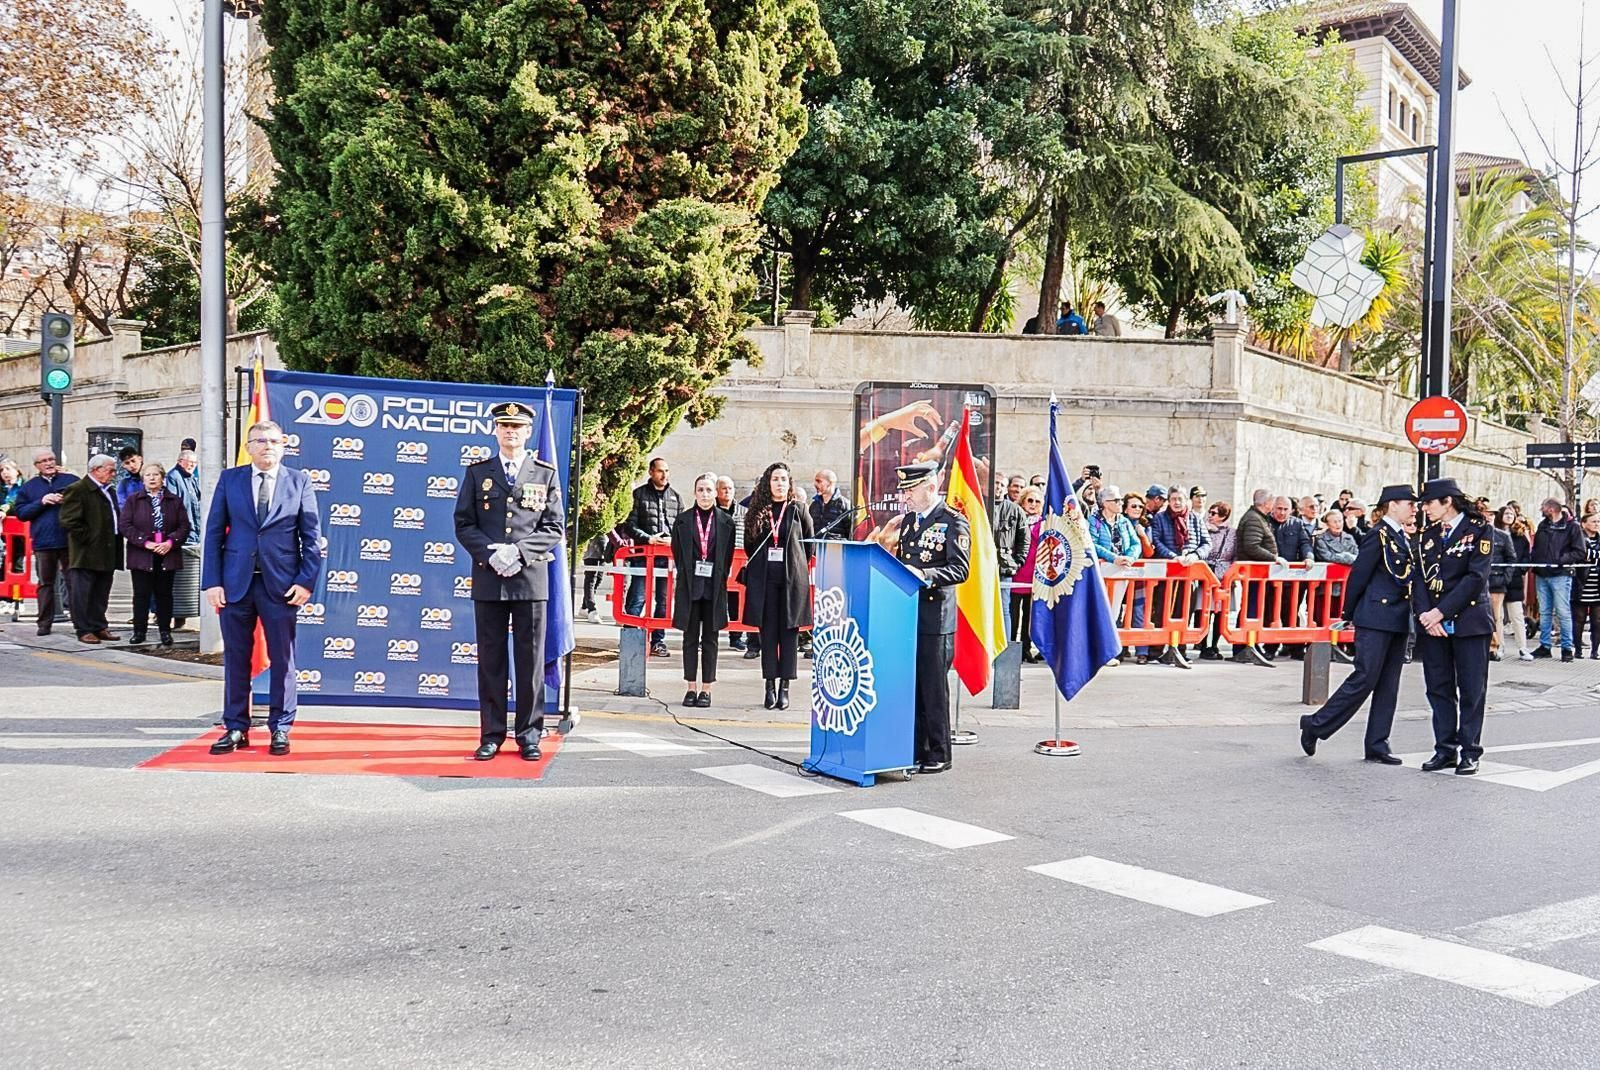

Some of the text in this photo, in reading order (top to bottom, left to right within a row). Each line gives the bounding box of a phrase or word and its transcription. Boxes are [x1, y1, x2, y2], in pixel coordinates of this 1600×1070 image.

[294, 390, 378, 427] 200
[382, 414, 496, 435] NACION
[333, 437, 363, 451] 200
[397, 442, 428, 454] 200
[461, 445, 491, 458] 200
[364, 473, 394, 486] 200
[428, 477, 458, 490] 200
[330, 504, 360, 517] 200
[394, 507, 424, 520] 200
[360, 539, 390, 552] 200
[424, 542, 454, 555] 200
[328, 571, 358, 584] 200
[391, 574, 421, 586] 200
[454, 576, 472, 589] 20
[358, 605, 388, 618] 200
[422, 608, 452, 621] 200
[324, 637, 355, 650] 200
[388, 639, 418, 652] 200
[355, 672, 385, 684] 200
[419, 674, 449, 687] 200
